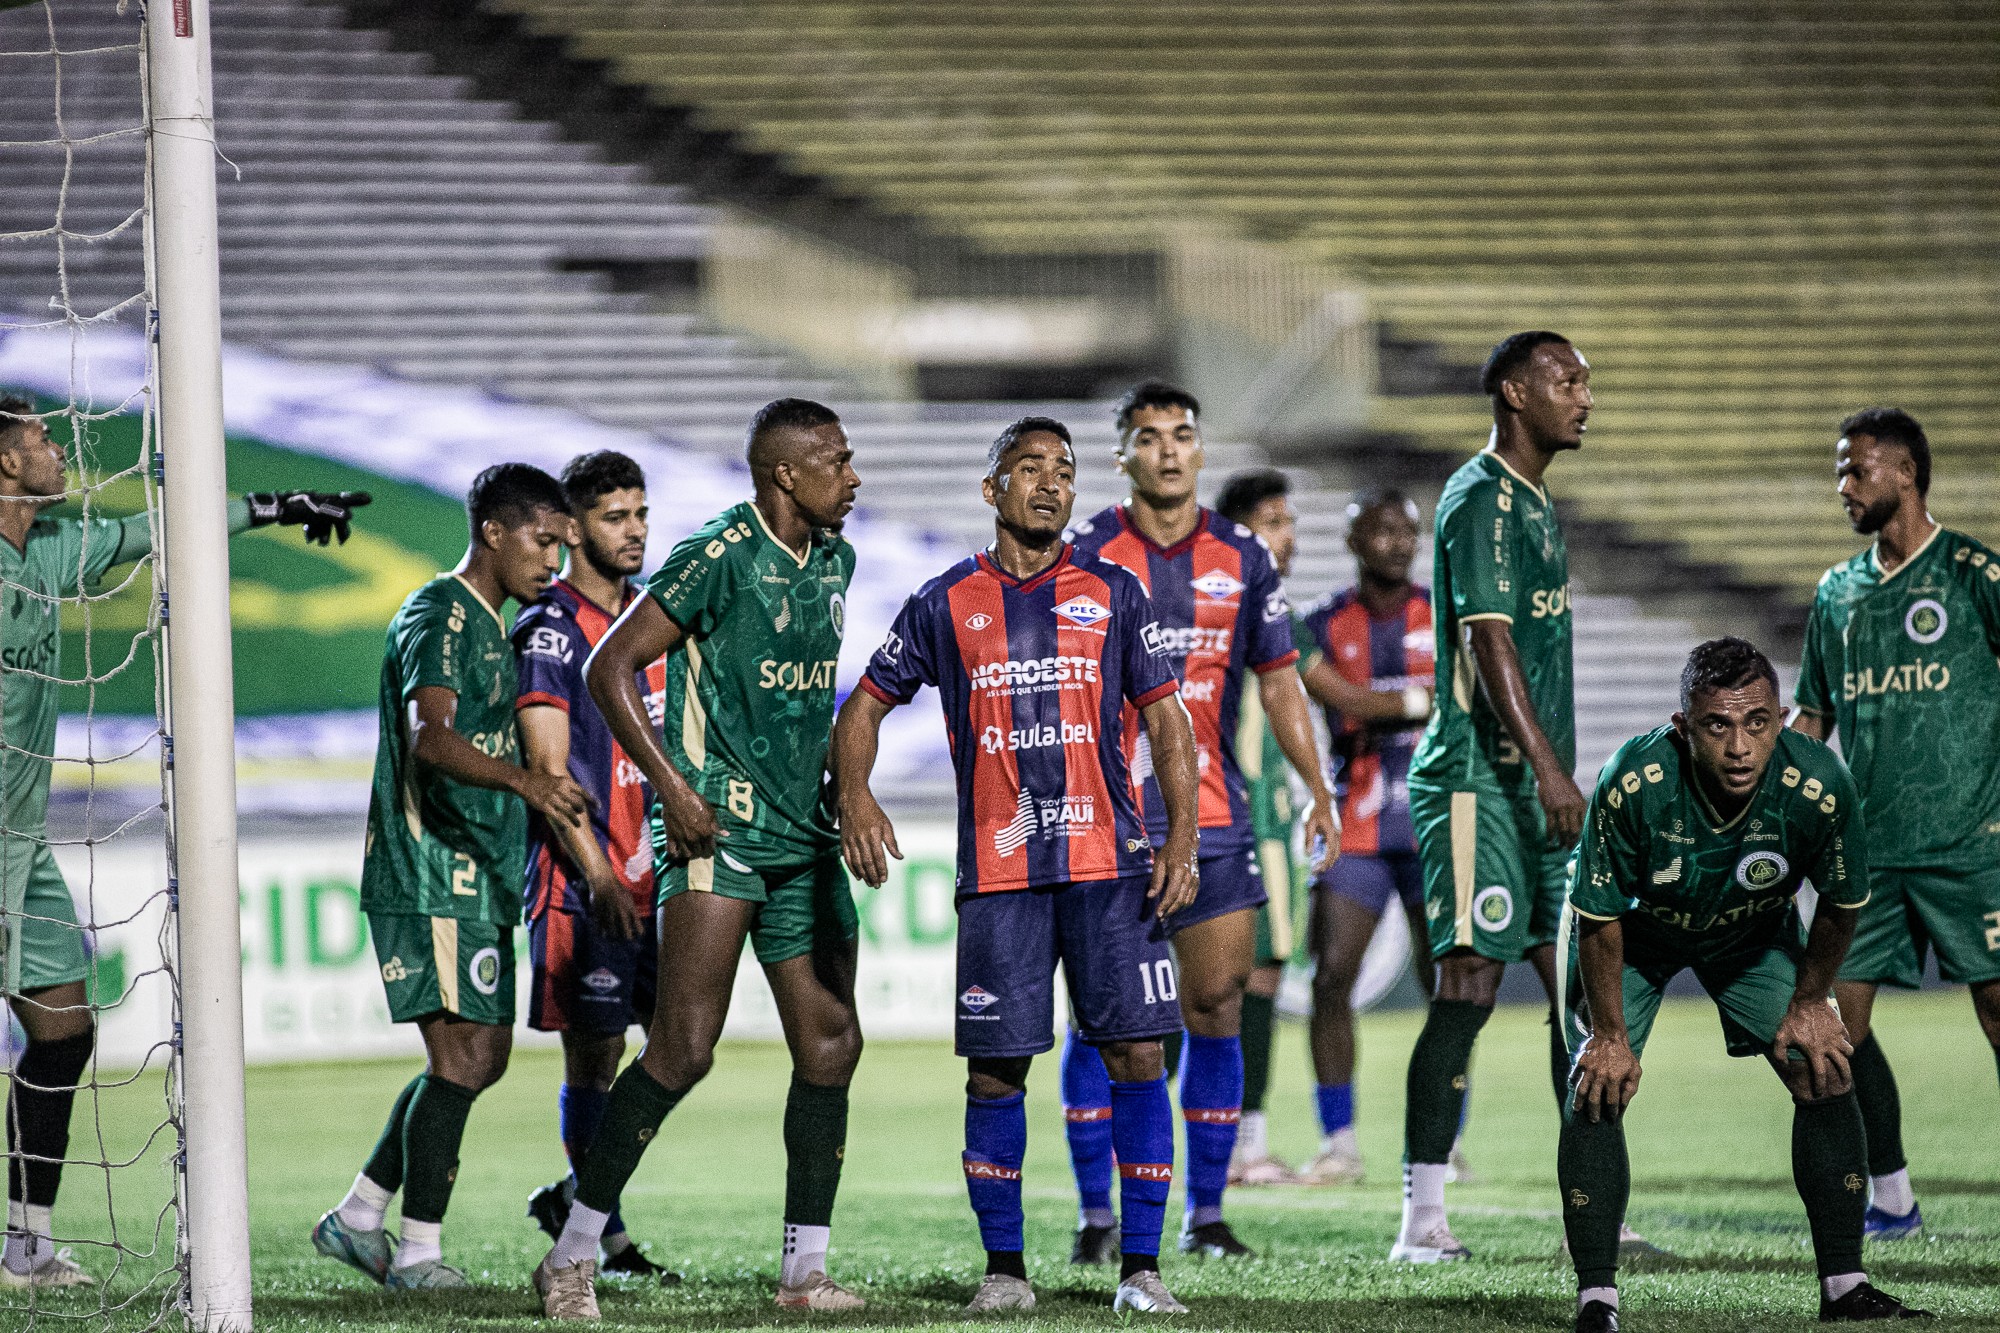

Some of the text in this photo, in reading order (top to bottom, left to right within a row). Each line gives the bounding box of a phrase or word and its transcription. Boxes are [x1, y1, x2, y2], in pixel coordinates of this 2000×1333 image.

[663, 559, 699, 600] BIG DATA
[1069, 605, 1097, 615] PEC
[971, 656, 1099, 691] NOROESTE
[1016, 686, 1032, 696] QUE
[728, 778, 754, 822] 8
[1040, 795, 1095, 808] GOVRNO DO
[452, 852, 478, 896] 2
[1836, 855, 1848, 881] DATA
[1138, 958, 1177, 1005] 10
[966, 995, 986, 1003] PEC
